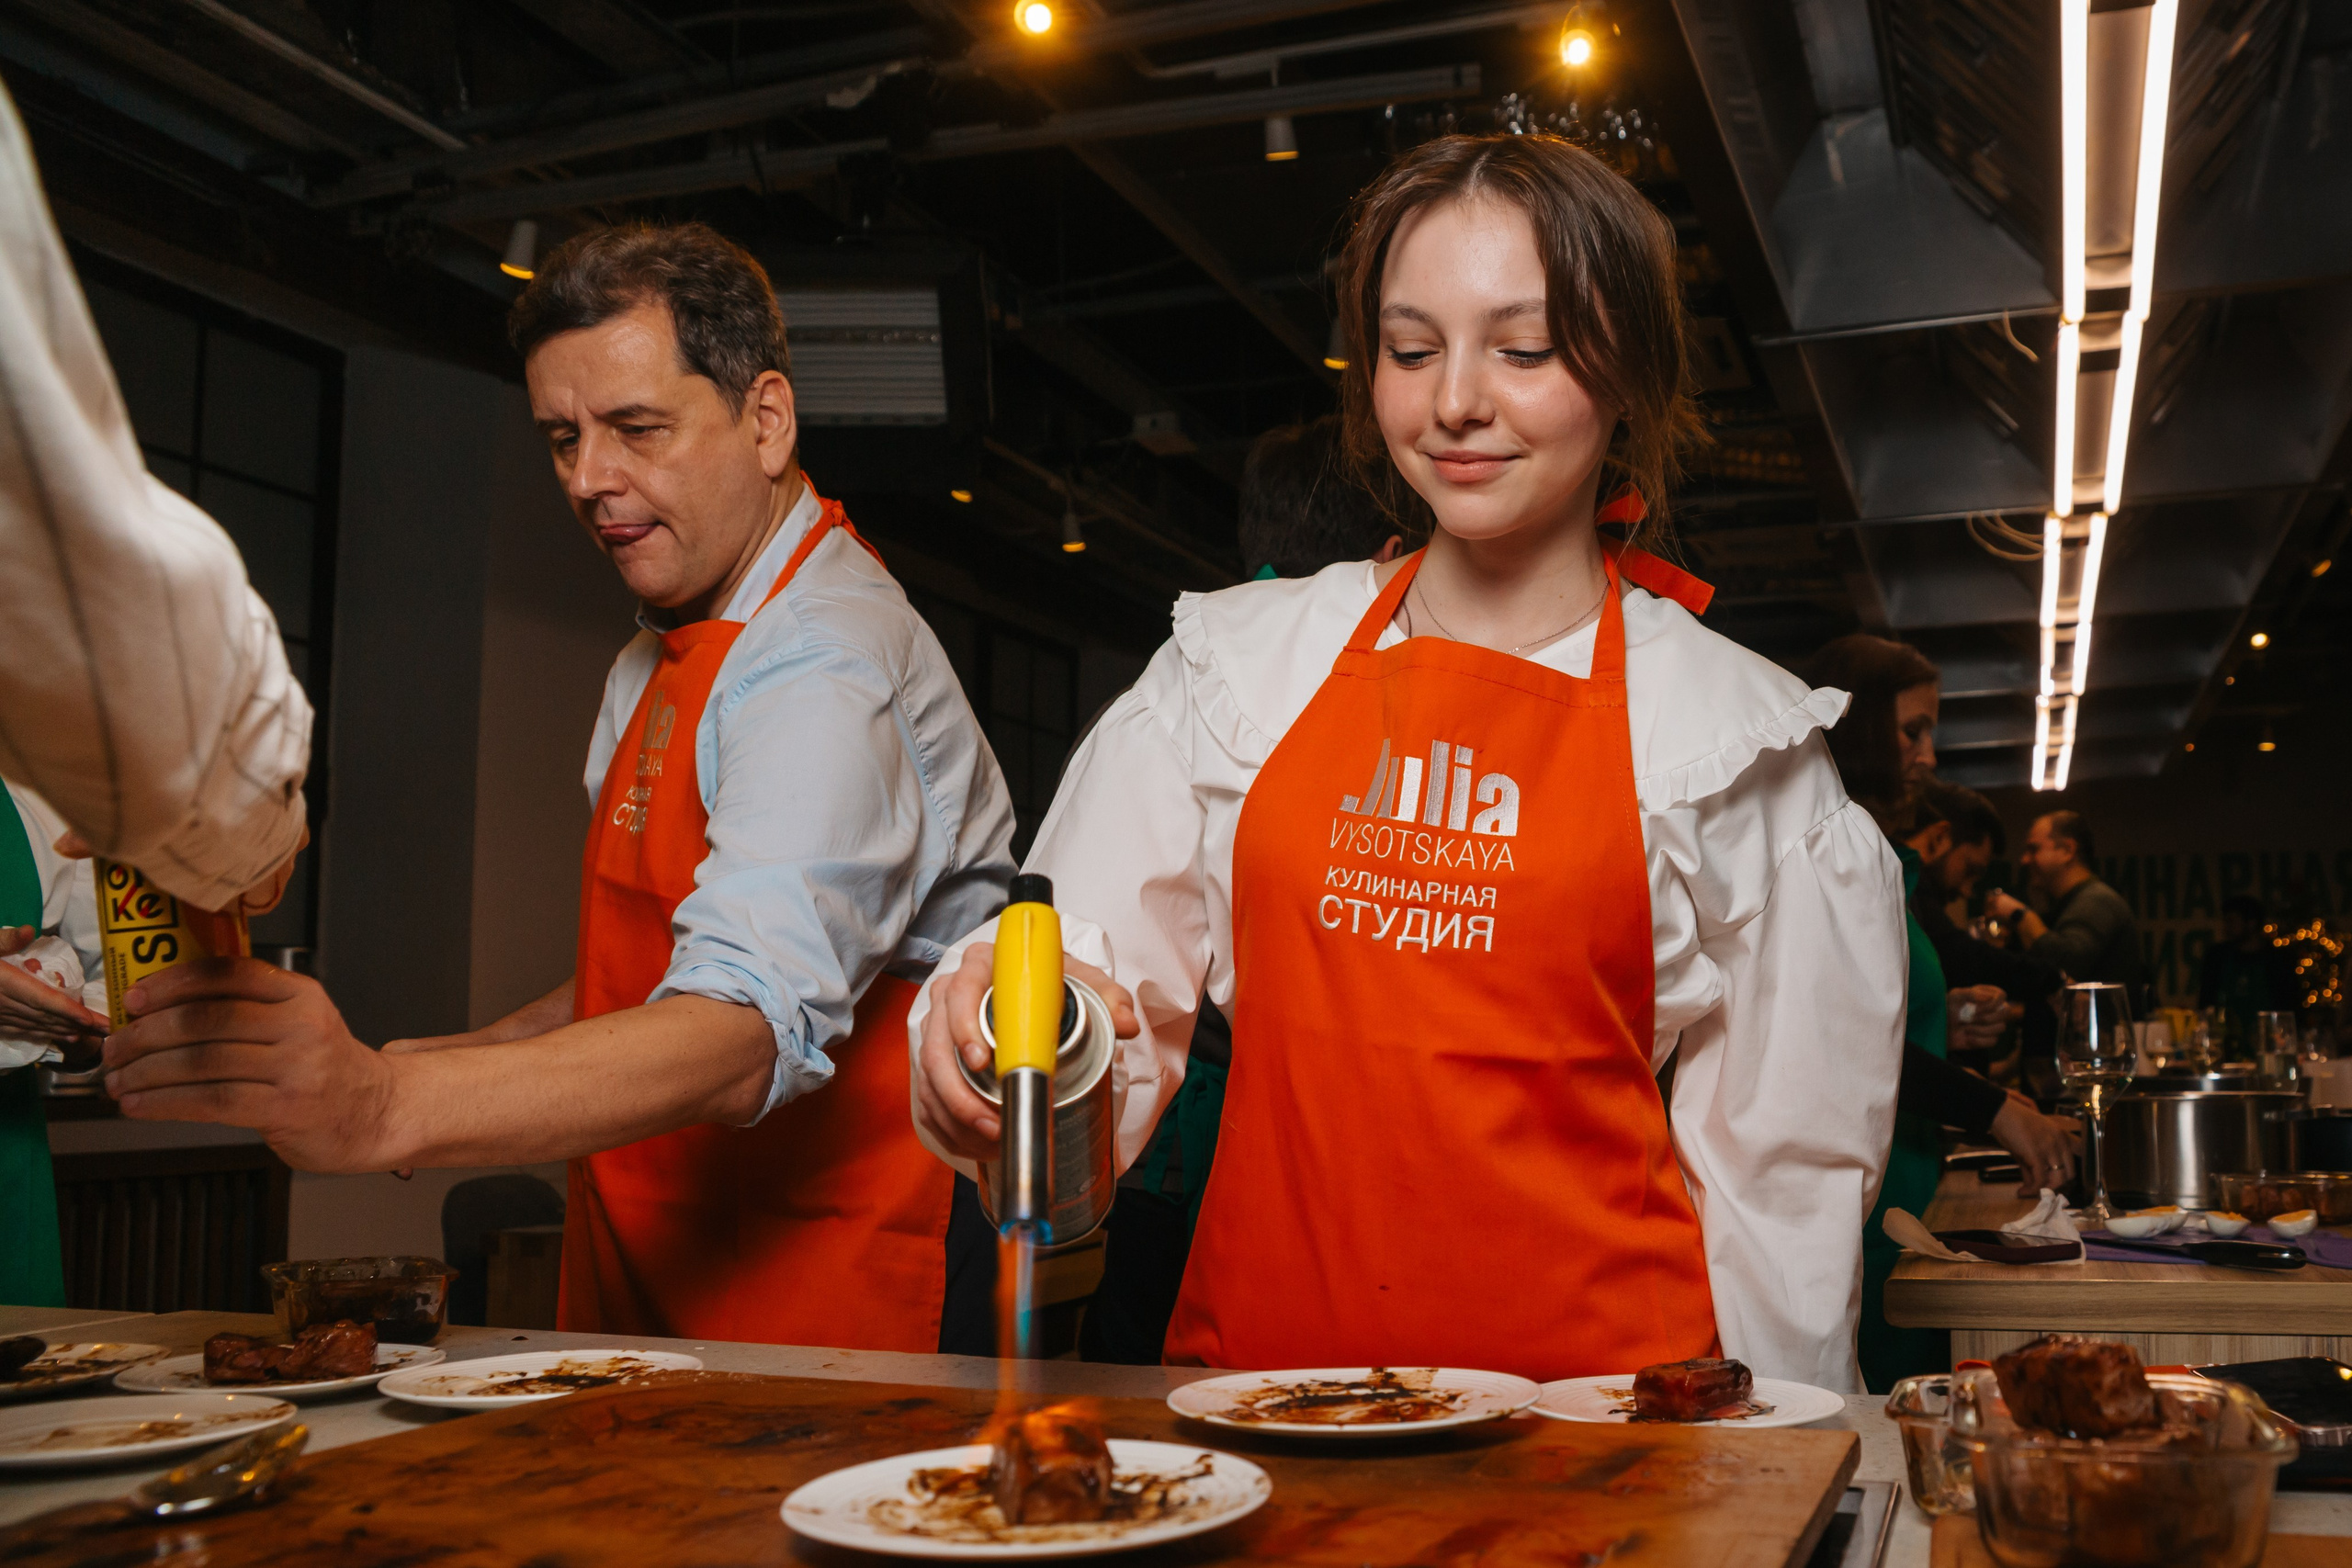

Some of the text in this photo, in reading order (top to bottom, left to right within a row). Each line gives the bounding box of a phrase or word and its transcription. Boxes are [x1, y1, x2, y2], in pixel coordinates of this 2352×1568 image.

[1339, 738, 1520, 837] Julia
[1330, 818, 1514, 872] VYSOTSKAYA
[1324, 865, 1497, 909] КУЛИНАРНАЯ
[1318, 895, 1495, 953] СТУДИЯ
[118, 952, 128, 990] IGRADE
